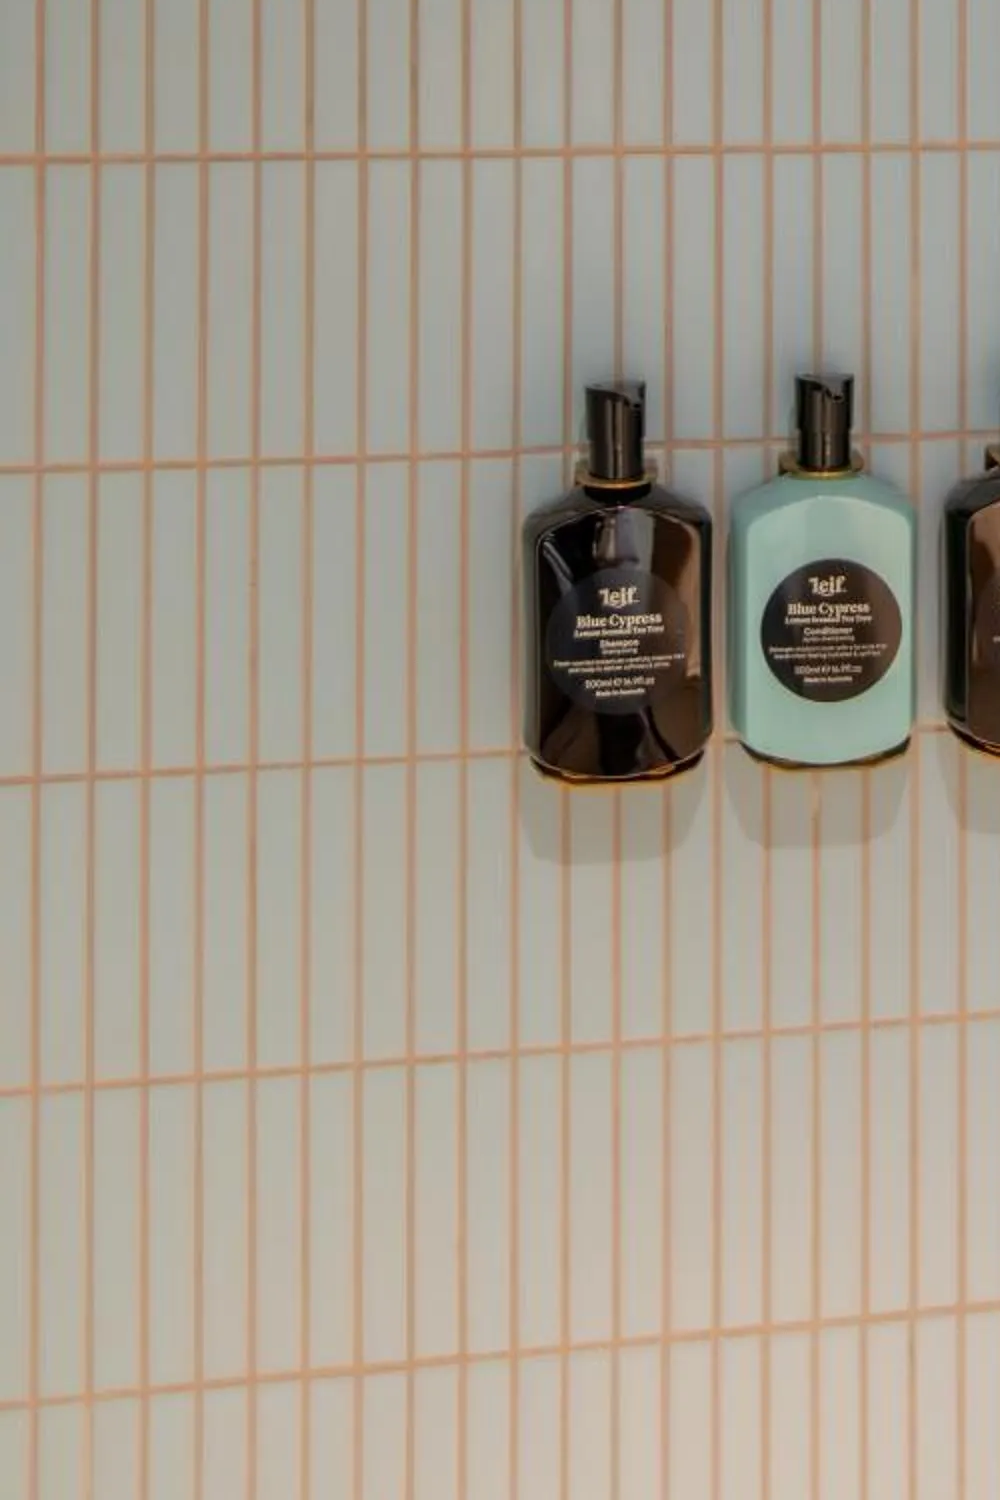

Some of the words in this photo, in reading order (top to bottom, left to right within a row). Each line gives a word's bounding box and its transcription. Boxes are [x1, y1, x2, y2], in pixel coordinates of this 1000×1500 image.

[787, 601, 816, 615] Blue
[818, 601, 870, 619] Cypress
[577, 614, 607, 628] Blue
[609, 613, 662, 628] Cypress
